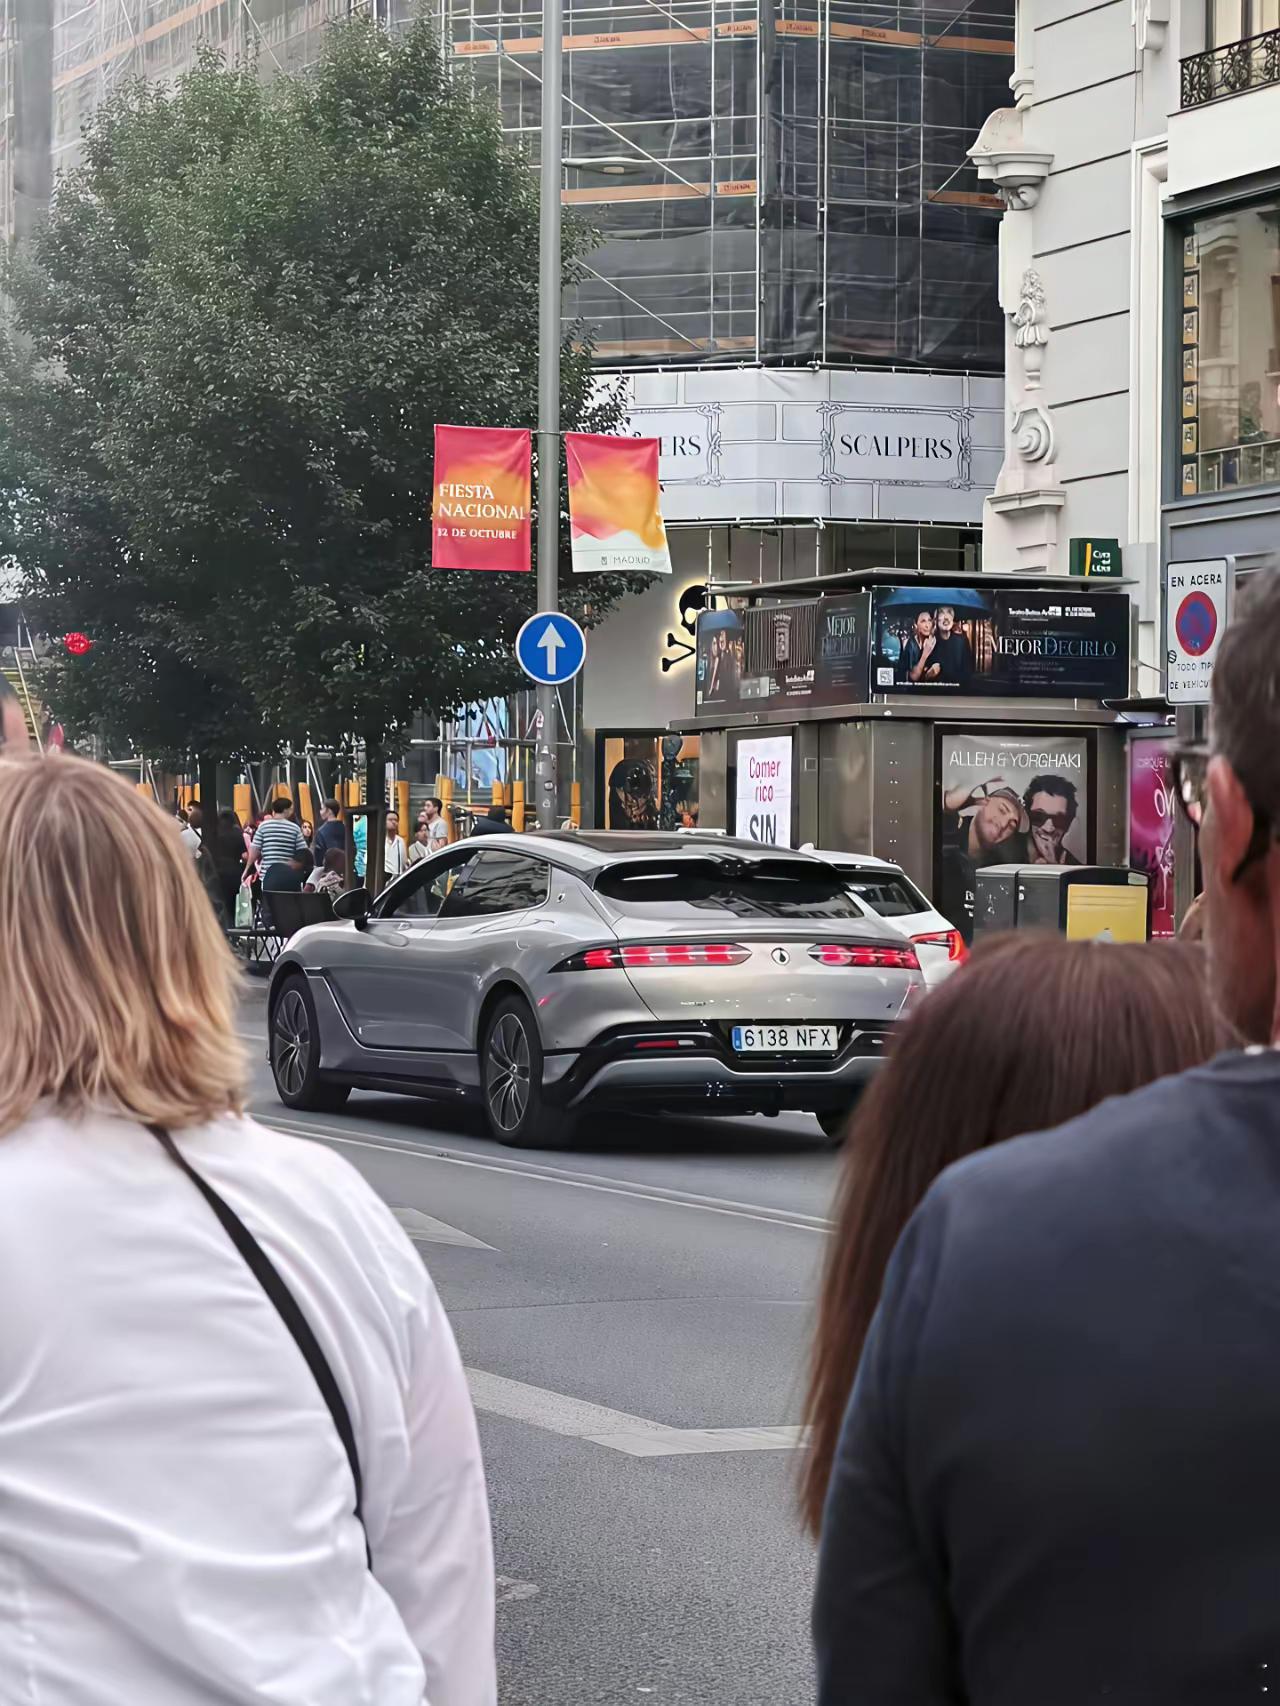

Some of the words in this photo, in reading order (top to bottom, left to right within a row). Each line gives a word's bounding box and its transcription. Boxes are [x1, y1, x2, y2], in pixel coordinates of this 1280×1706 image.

[839, 434, 952, 460] SCALPERS
[439, 483, 495, 500] FIESTA
[438, 503, 526, 520] NACIONAL
[451, 528, 467, 537] DE
[469, 529, 518, 540] OCTUBRE
[1171, 576, 1185, 587] EN
[1190, 574, 1222, 586] ACERA
[827, 616, 856, 638] MEJOR
[1177, 662, 1196, 671] TODO
[1169, 681, 1179, 690] DE
[749, 756, 781, 779] Comer
[949, 751, 994, 768] ALLEH
[996, 752, 1007, 767] &
[1010, 752, 1081, 768] YORGHAKI
[755, 780, 774, 802] rico
[749, 814, 777, 845] SIN
[744, 1029, 788, 1047] 6138
[796, 1029, 831, 1047] NFX
